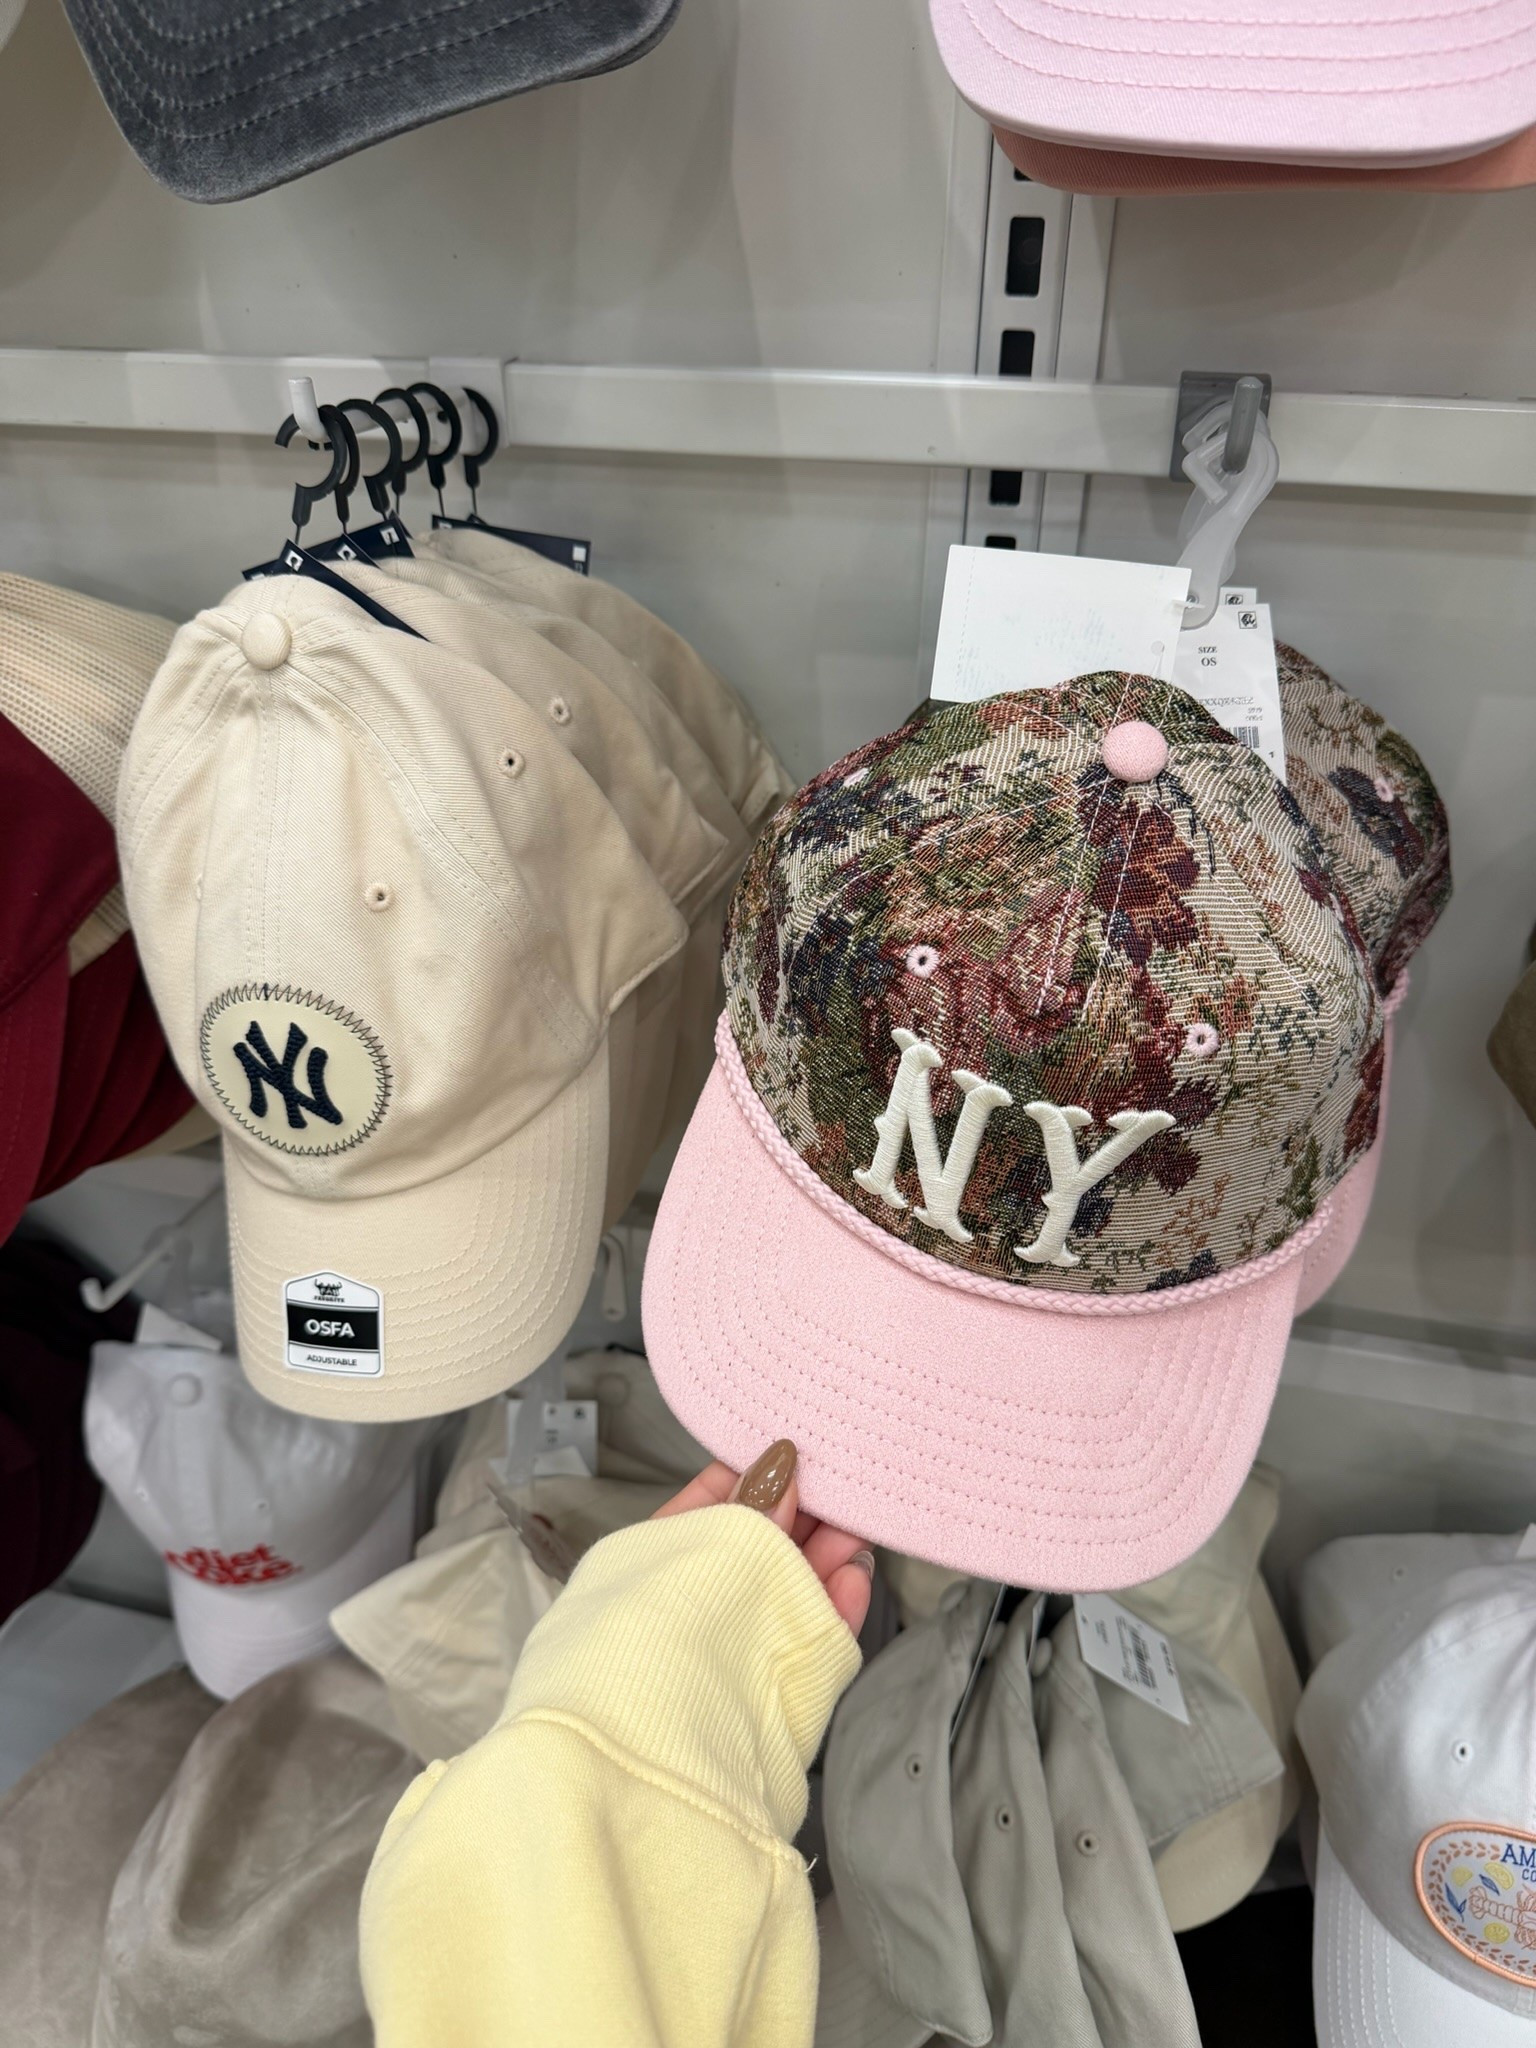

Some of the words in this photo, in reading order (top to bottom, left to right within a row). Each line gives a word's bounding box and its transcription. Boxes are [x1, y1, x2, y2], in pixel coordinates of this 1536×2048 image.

[1198, 646, 1218, 654] SIZE
[1201, 657, 1217, 667] OS
[233, 1020, 343, 1129] NY
[852, 1027, 1176, 1267] NY
[304, 1319, 355, 1338] OSFA
[306, 1354, 357, 1366] ADJUSTABLE
